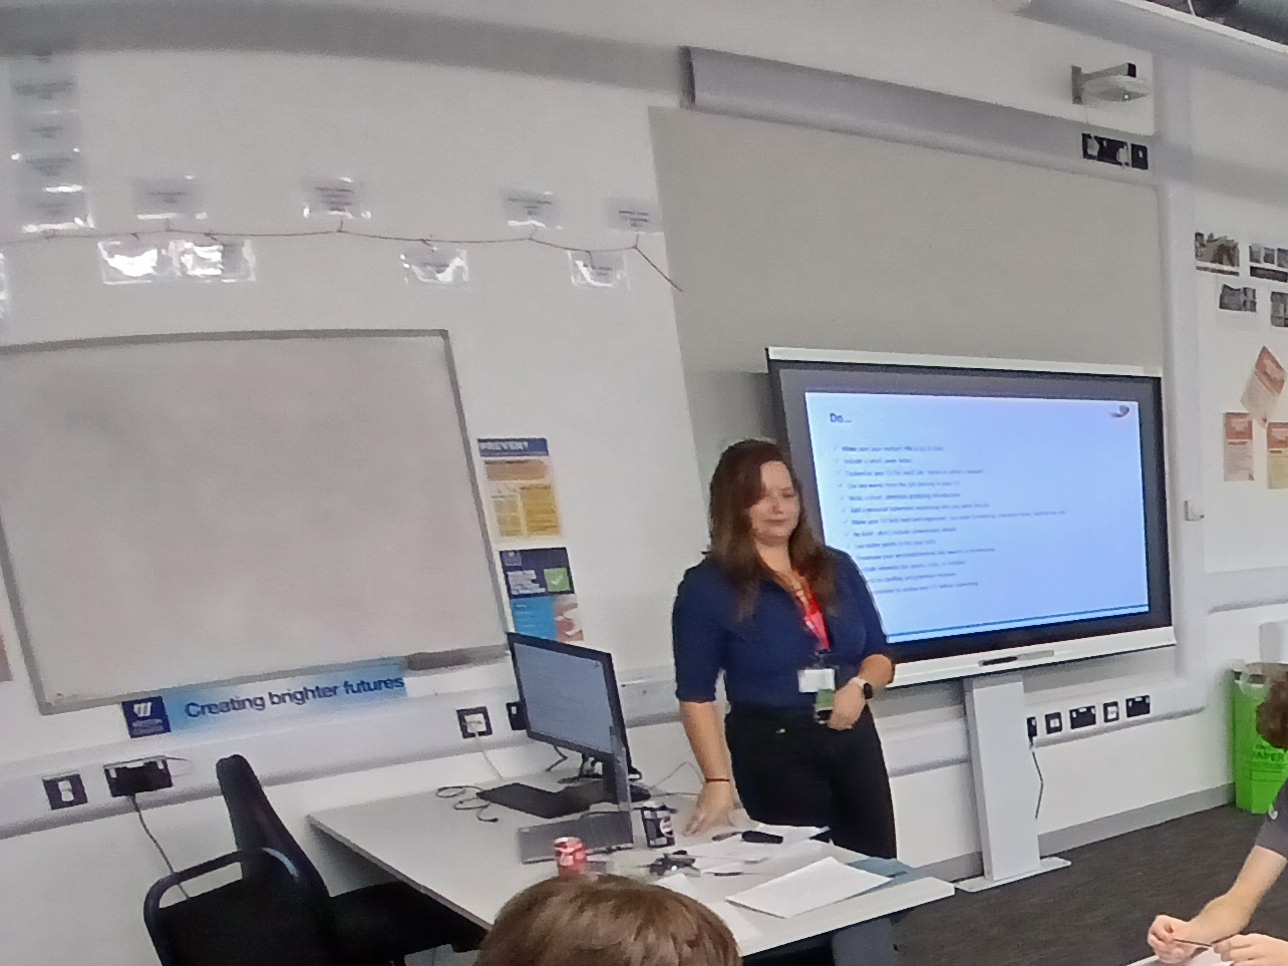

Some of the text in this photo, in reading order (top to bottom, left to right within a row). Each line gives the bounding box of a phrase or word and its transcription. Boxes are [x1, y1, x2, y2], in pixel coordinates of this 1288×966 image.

[185, 677, 405, 718] Creating brighter futures
